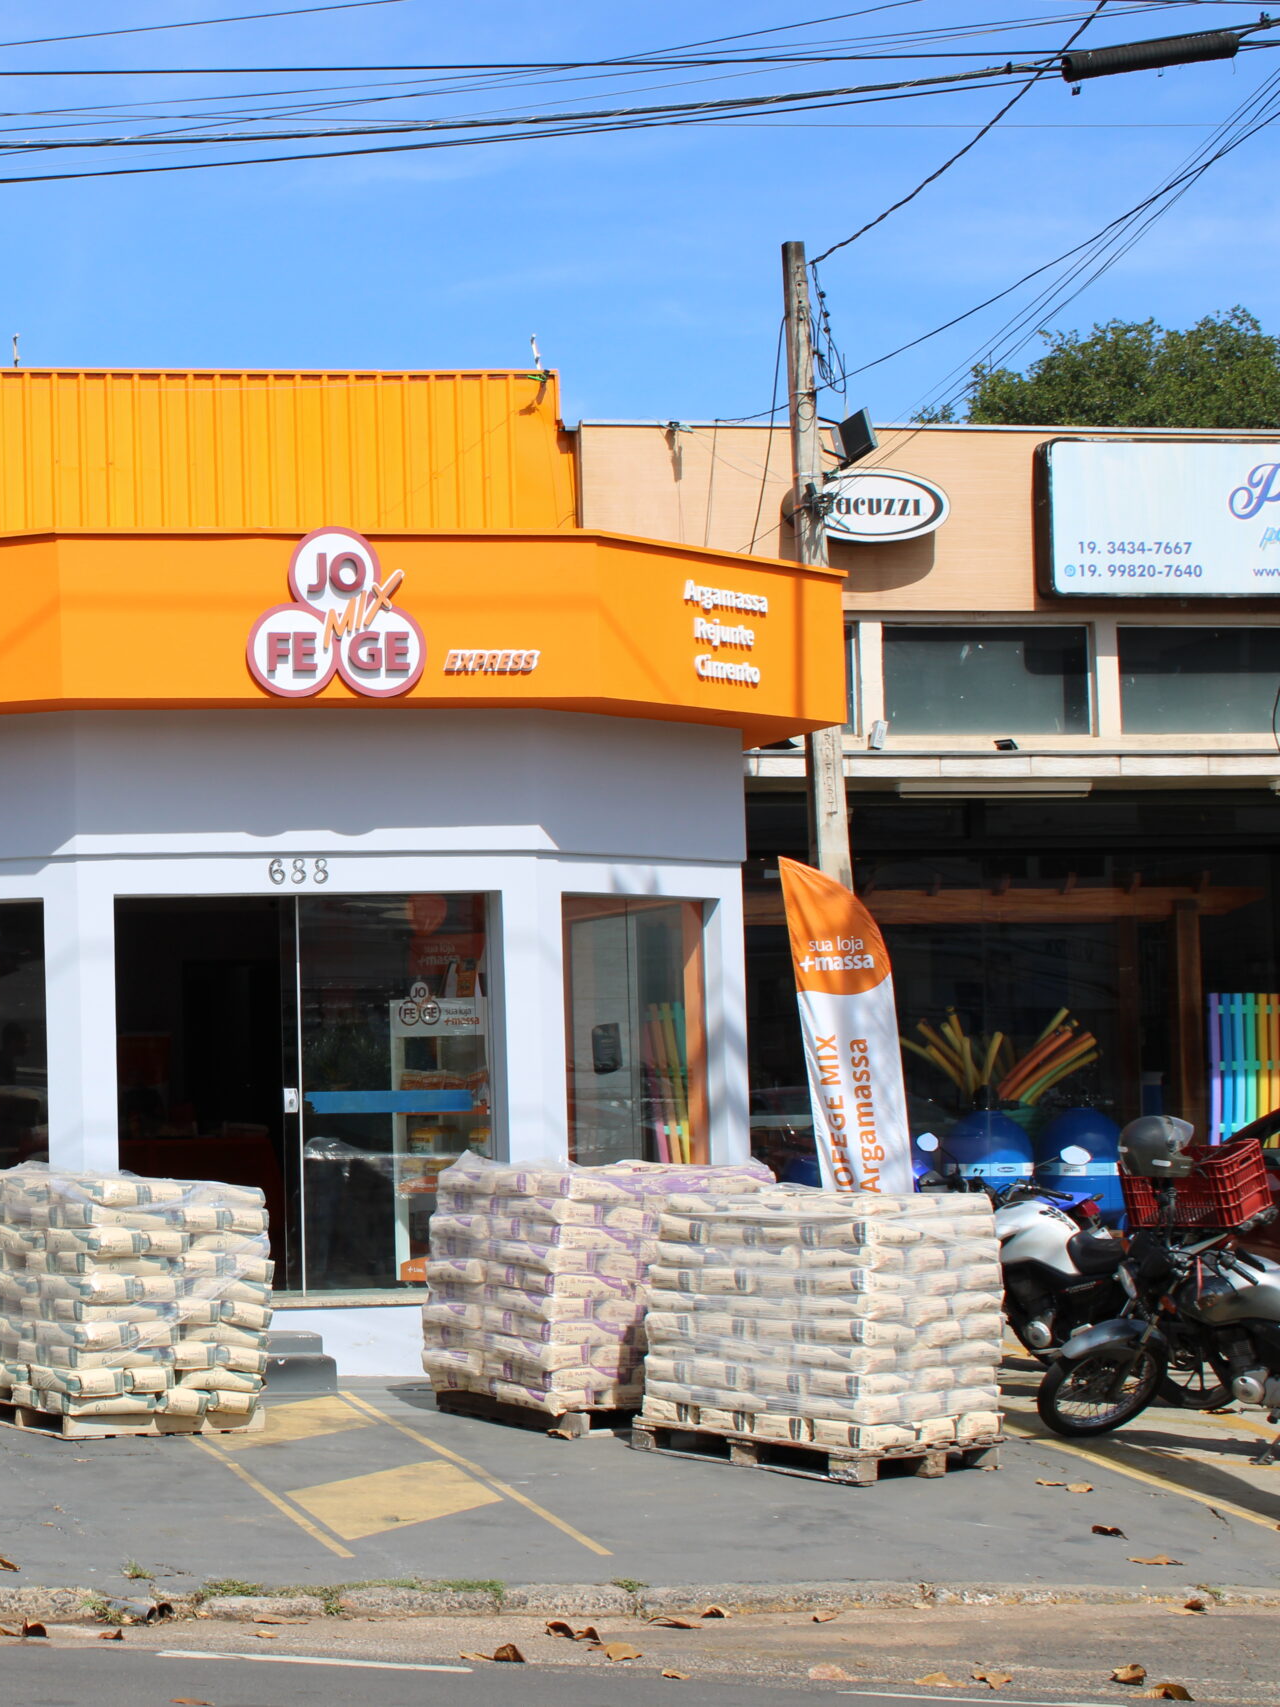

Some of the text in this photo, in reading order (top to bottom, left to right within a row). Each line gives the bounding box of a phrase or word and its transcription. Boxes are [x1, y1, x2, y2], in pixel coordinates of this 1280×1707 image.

[1078, 541, 1192, 555] 19. 3434-7667
[307, 551, 367, 593] JO
[1078, 564, 1203, 578] 19. 99820-7640
[683, 579, 769, 613] Argamassa
[323, 569, 406, 652] MIX
[693, 617, 755, 646] Rejunte
[267, 631, 411, 672] FE GE
[443, 649, 541, 673] EXPRESS
[694, 654, 761, 683] Cimento
[268, 858, 328, 885] 688
[808, 936, 864, 954] sua loja
[799, 953, 875, 973] +massa
[412, 987, 427, 999] JO
[403, 1007, 437, 1019] FE GE
[816, 1034, 842, 1086] MIX
[850, 1038, 885, 1193] Argamassa
